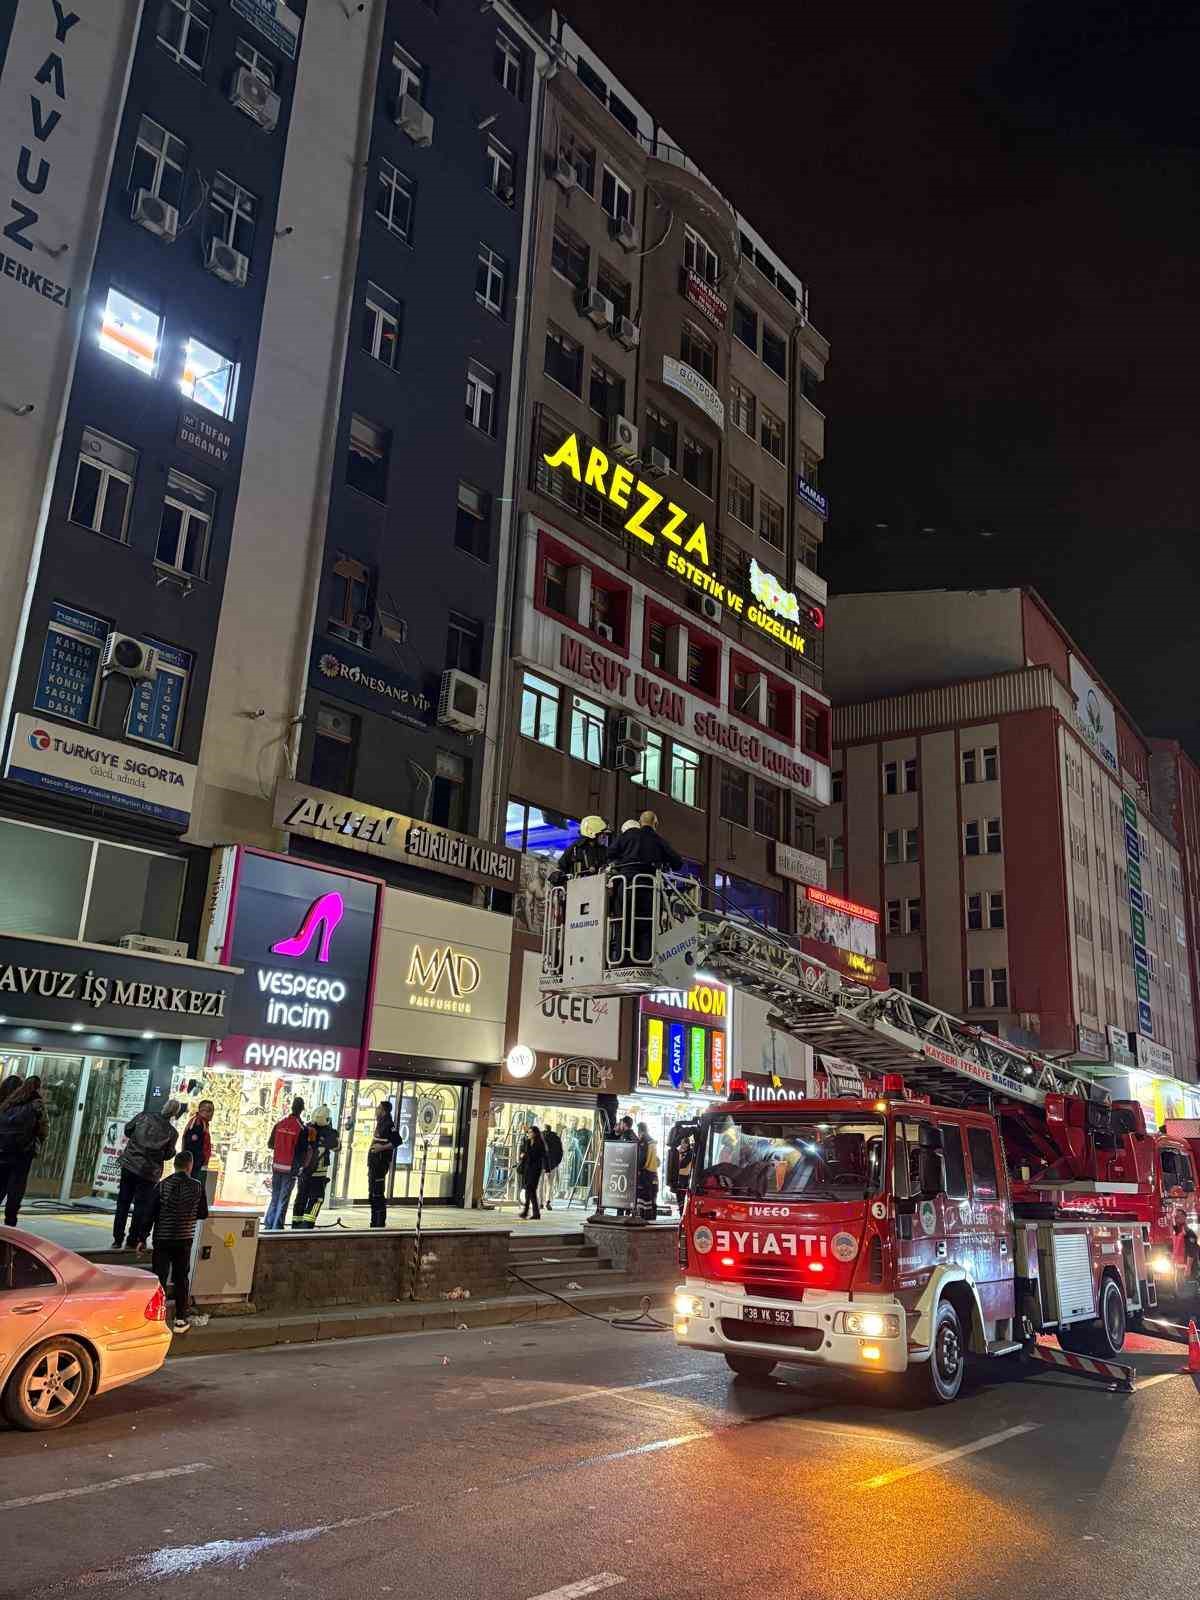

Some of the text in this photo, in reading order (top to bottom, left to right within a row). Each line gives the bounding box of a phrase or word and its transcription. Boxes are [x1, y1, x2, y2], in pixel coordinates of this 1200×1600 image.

[3, 0, 81, 251] YAVUZ
[543, 432, 709, 566] AREZZA
[666, 550, 806, 655] ESTETİK VE GÜZELLİK
[55, 635, 92, 656] KASKO
[48, 673, 86, 692] KONUT
[48, 699, 77, 717] DASK
[560, 632, 813, 789] MESUT UÇAN SÜRÜCÜ KURSU
[406, 822, 516, 882] SÜRÜCÜ KURSU
[569, 919, 600, 930] MAGIRUS
[657, 935, 698, 964] MAGIRUS
[405, 943, 482, 999] MAD
[0, 962, 228, 1018] AVUZ İŞ MERKEZİ
[257, 968, 347, 1005] VESPERO
[244, 1042, 343, 1073] AYAKKABI
[673, 1034, 683, 1073] ÇANTA
[991, 1072, 1023, 1094] MAGIRUS
[608, 1174, 628, 1193] 50
[749, 1207, 790, 1217] IVECO
[875, 1204, 883, 1216] 3
[748, 1308, 791, 1324] 38 VK 562
